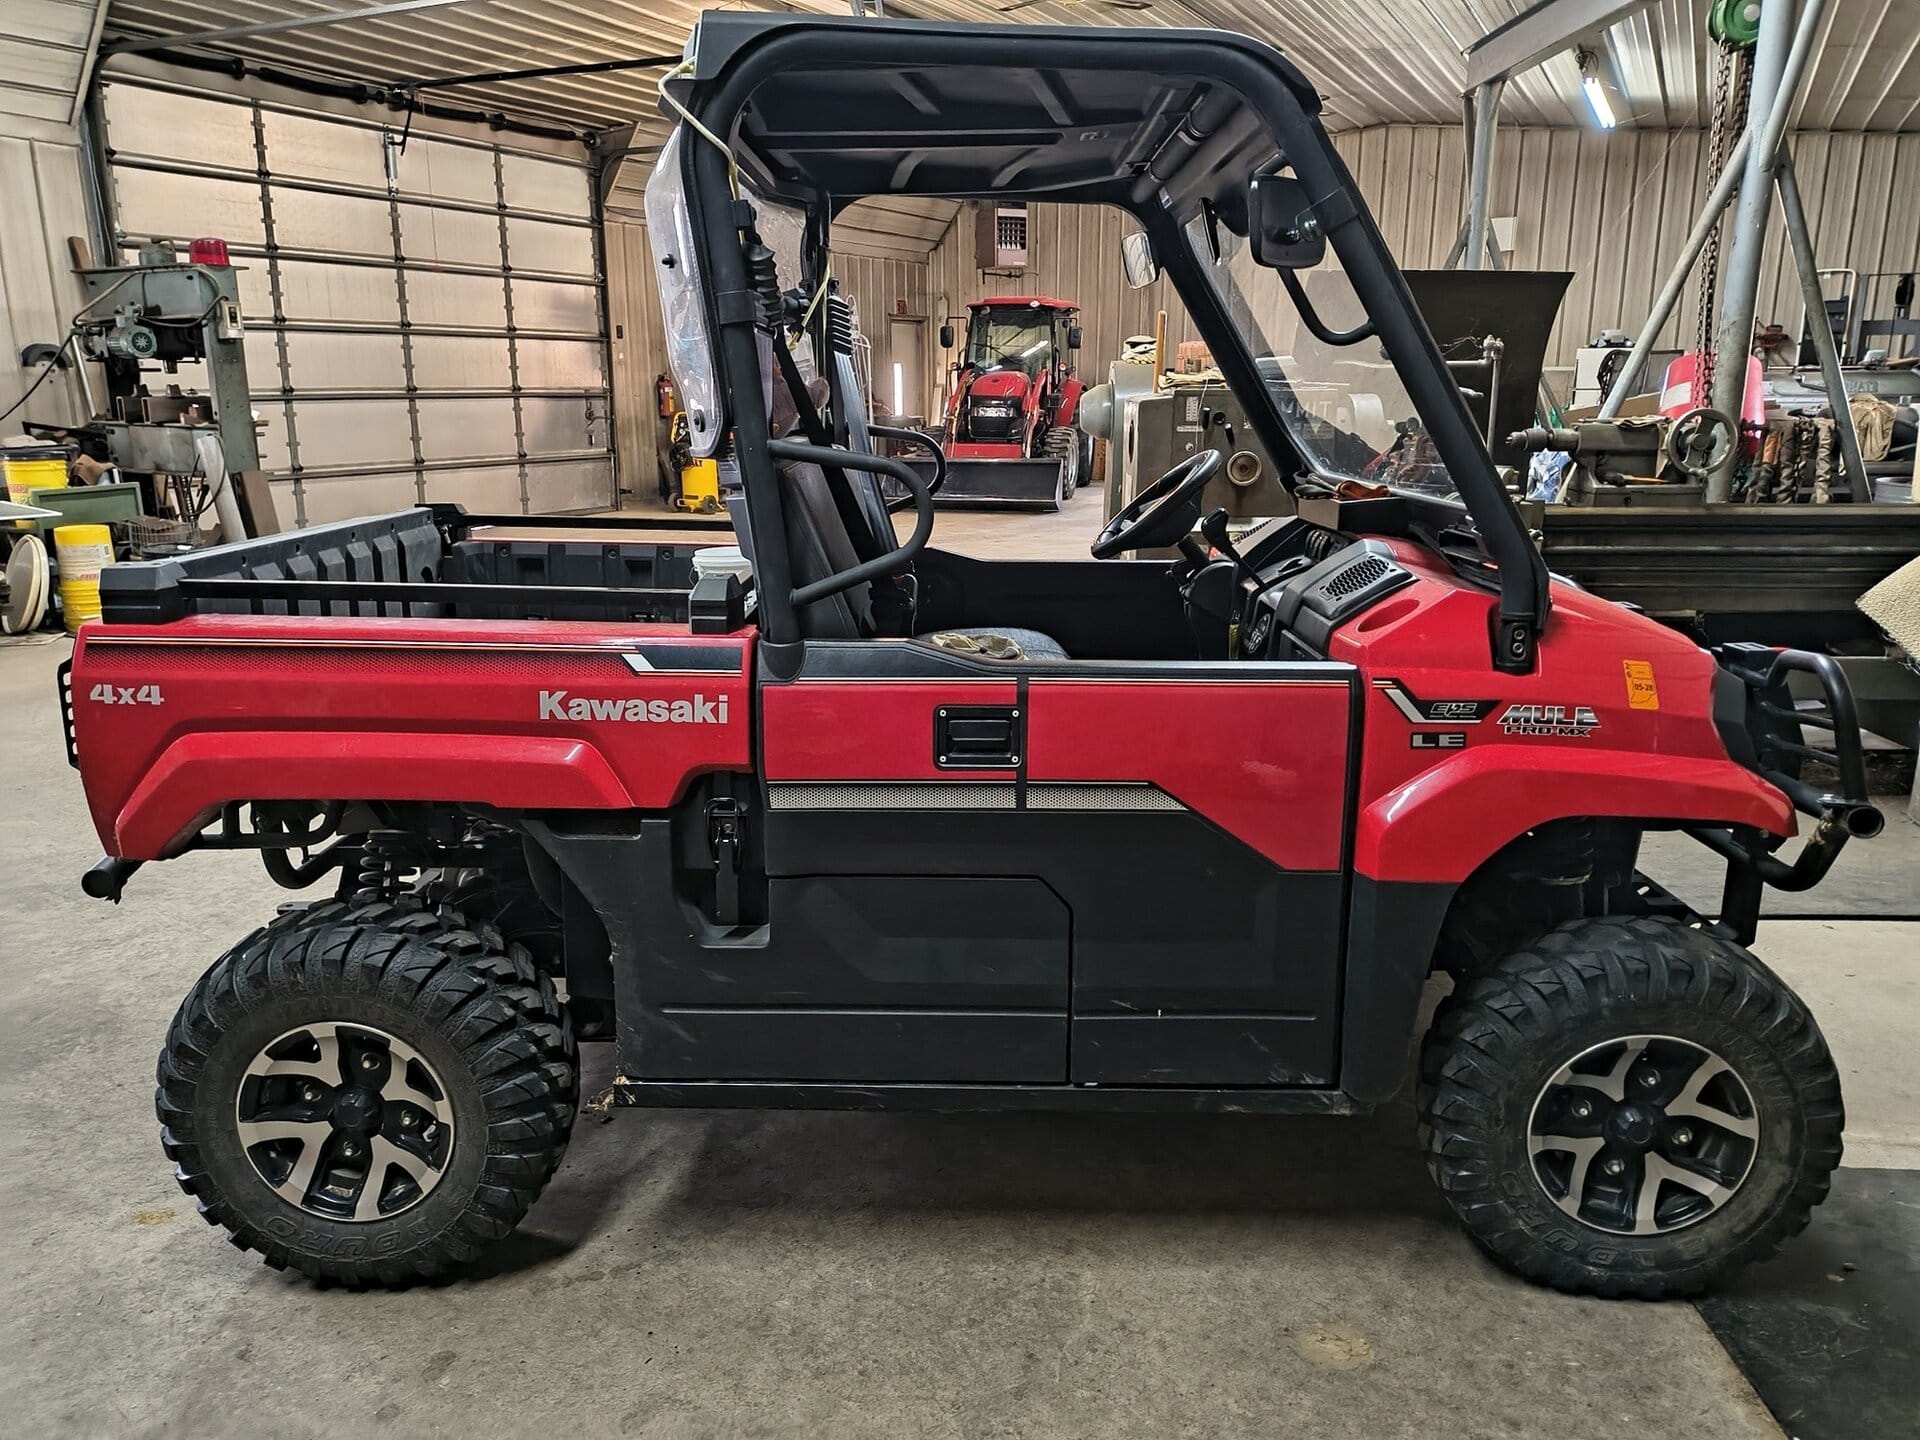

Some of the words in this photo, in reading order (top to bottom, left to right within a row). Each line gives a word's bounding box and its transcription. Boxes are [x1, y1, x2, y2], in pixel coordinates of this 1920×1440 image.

[89, 684, 165, 705] 4x4
[539, 691, 728, 724] Kawasaki
[1497, 704, 1602, 728] MULE
[1412, 734, 1464, 747] LE
[266, 1215, 401, 1256] DURO
